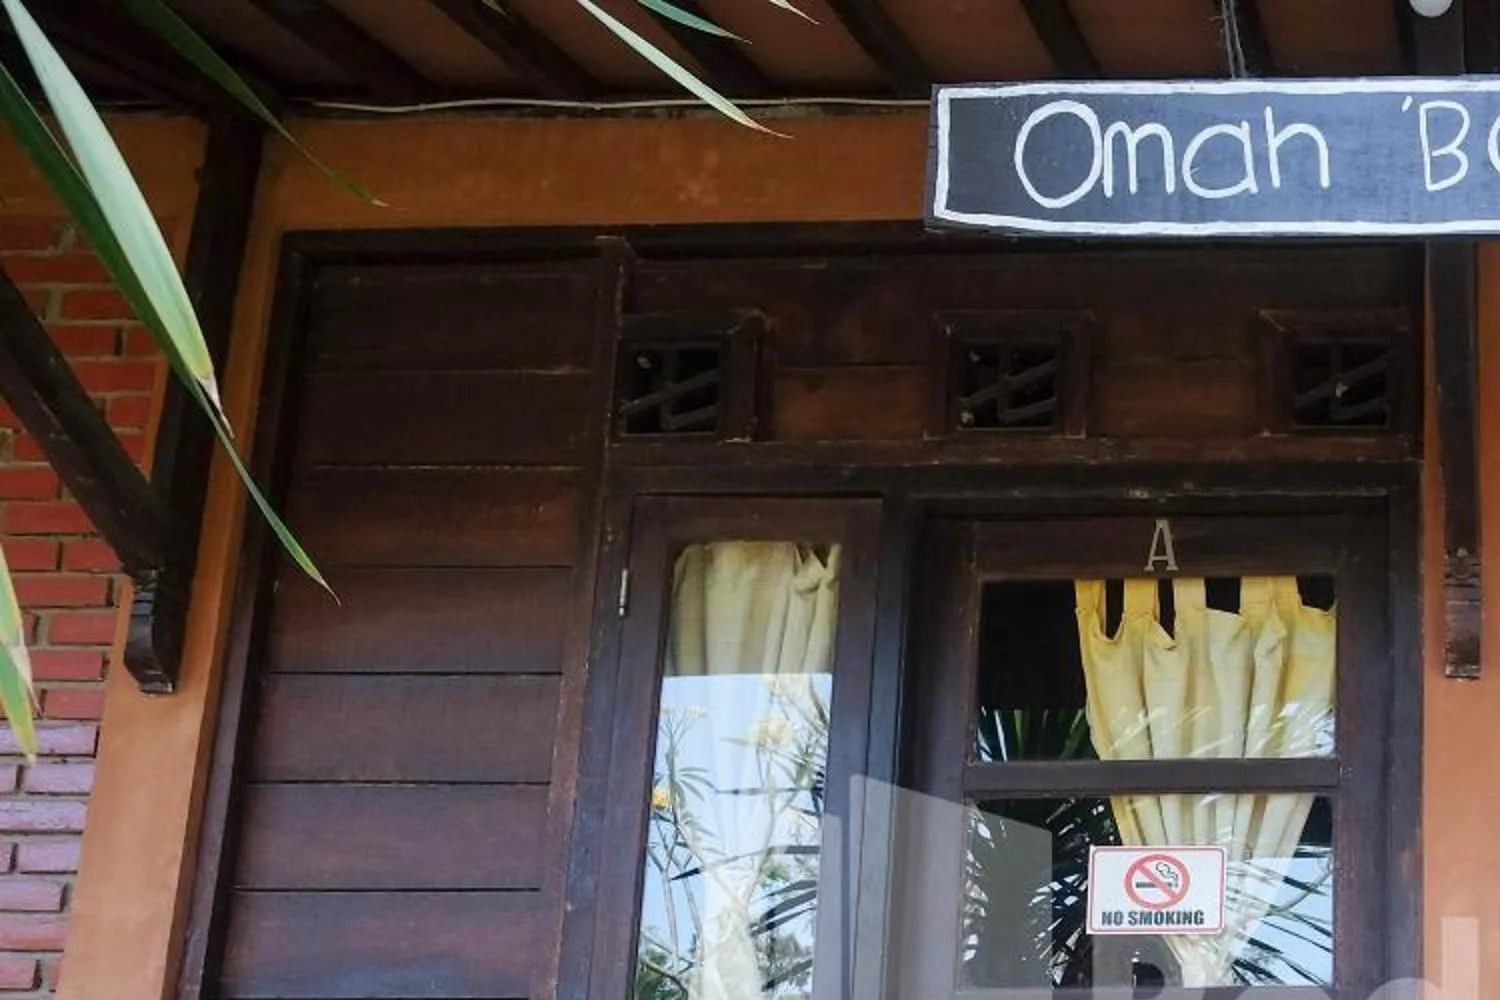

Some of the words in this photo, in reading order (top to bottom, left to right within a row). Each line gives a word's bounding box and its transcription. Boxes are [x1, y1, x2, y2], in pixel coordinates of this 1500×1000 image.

[1013, 100, 1330, 209] Omah
[1143, 519, 1179, 571] A
[1101, 911, 1124, 926] NO
[1127, 910, 1205, 926] SMOKING
